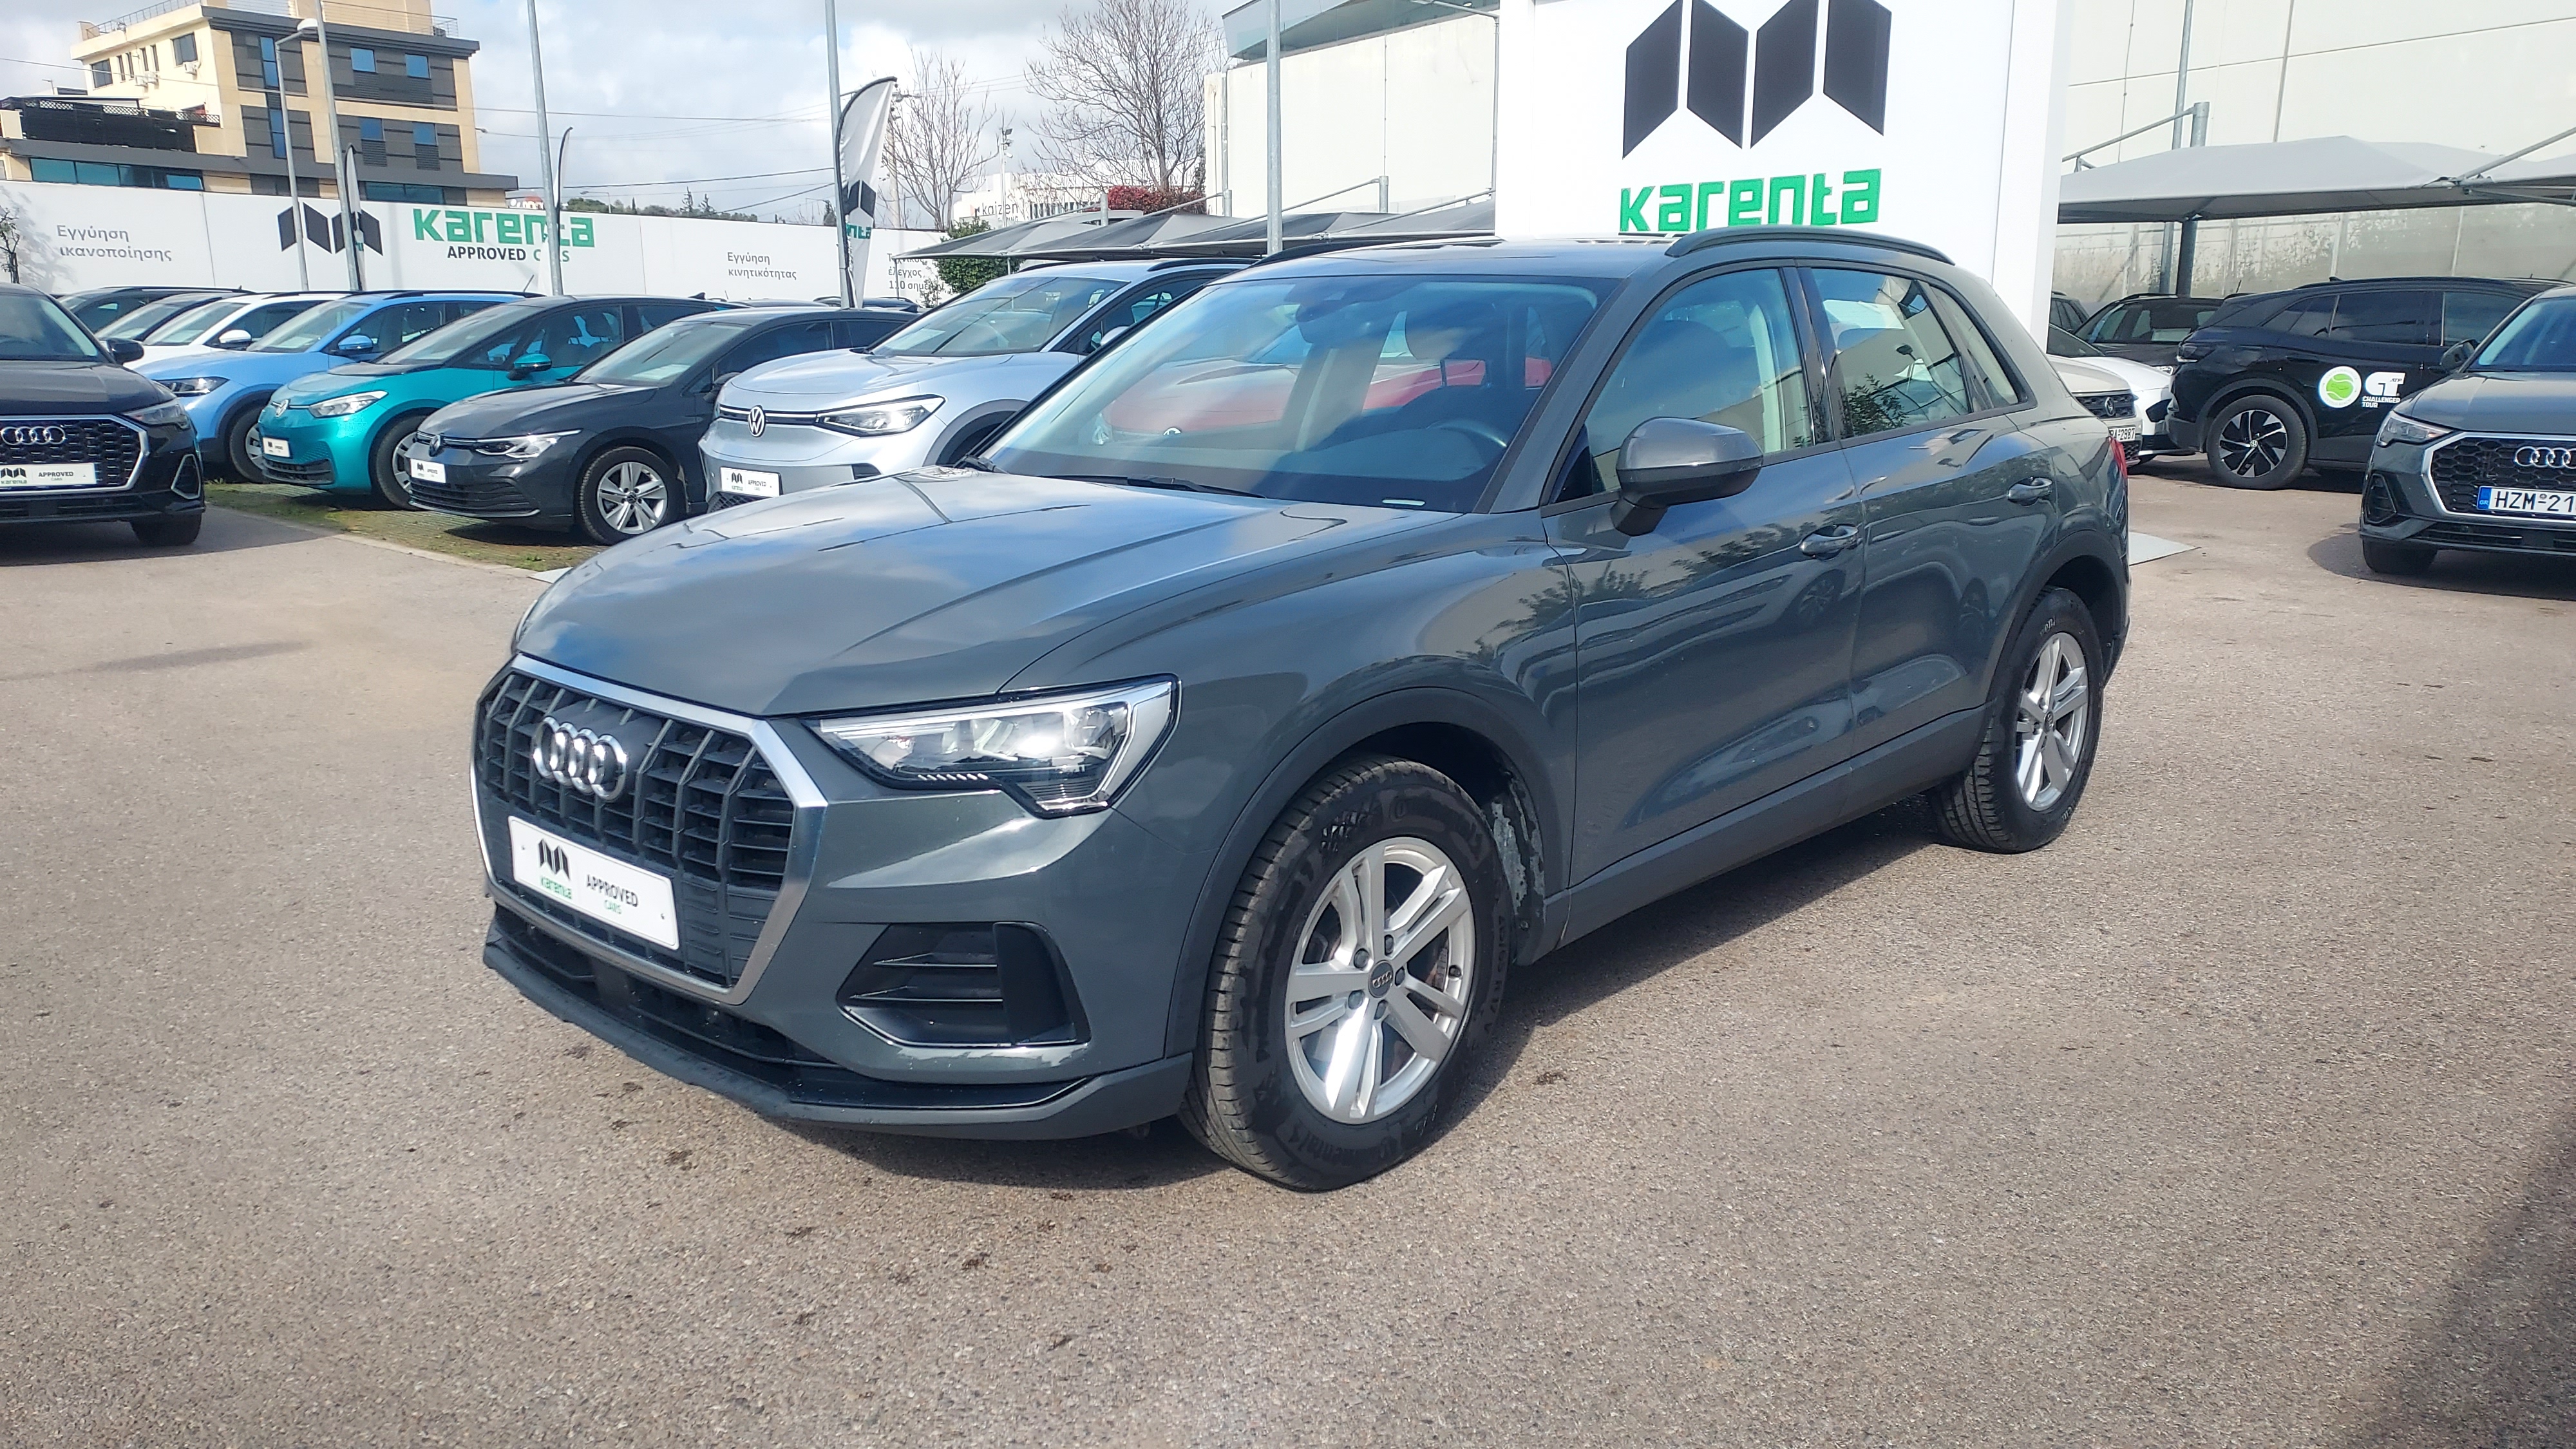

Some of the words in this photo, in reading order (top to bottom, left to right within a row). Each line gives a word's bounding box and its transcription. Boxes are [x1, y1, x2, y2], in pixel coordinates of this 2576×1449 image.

[981, 201, 1018, 215] kaizen
[57, 224, 129, 243] Εγγύηση
[59, 245, 172, 262] ικανοποίησης
[447, 245, 526, 261] APPROVED
[533, 249, 570, 262] CS
[727, 252, 770, 265] Εγγύηση
[728, 267, 797, 281] κινητικότητας
[587, 873, 638, 907] APPROVED
